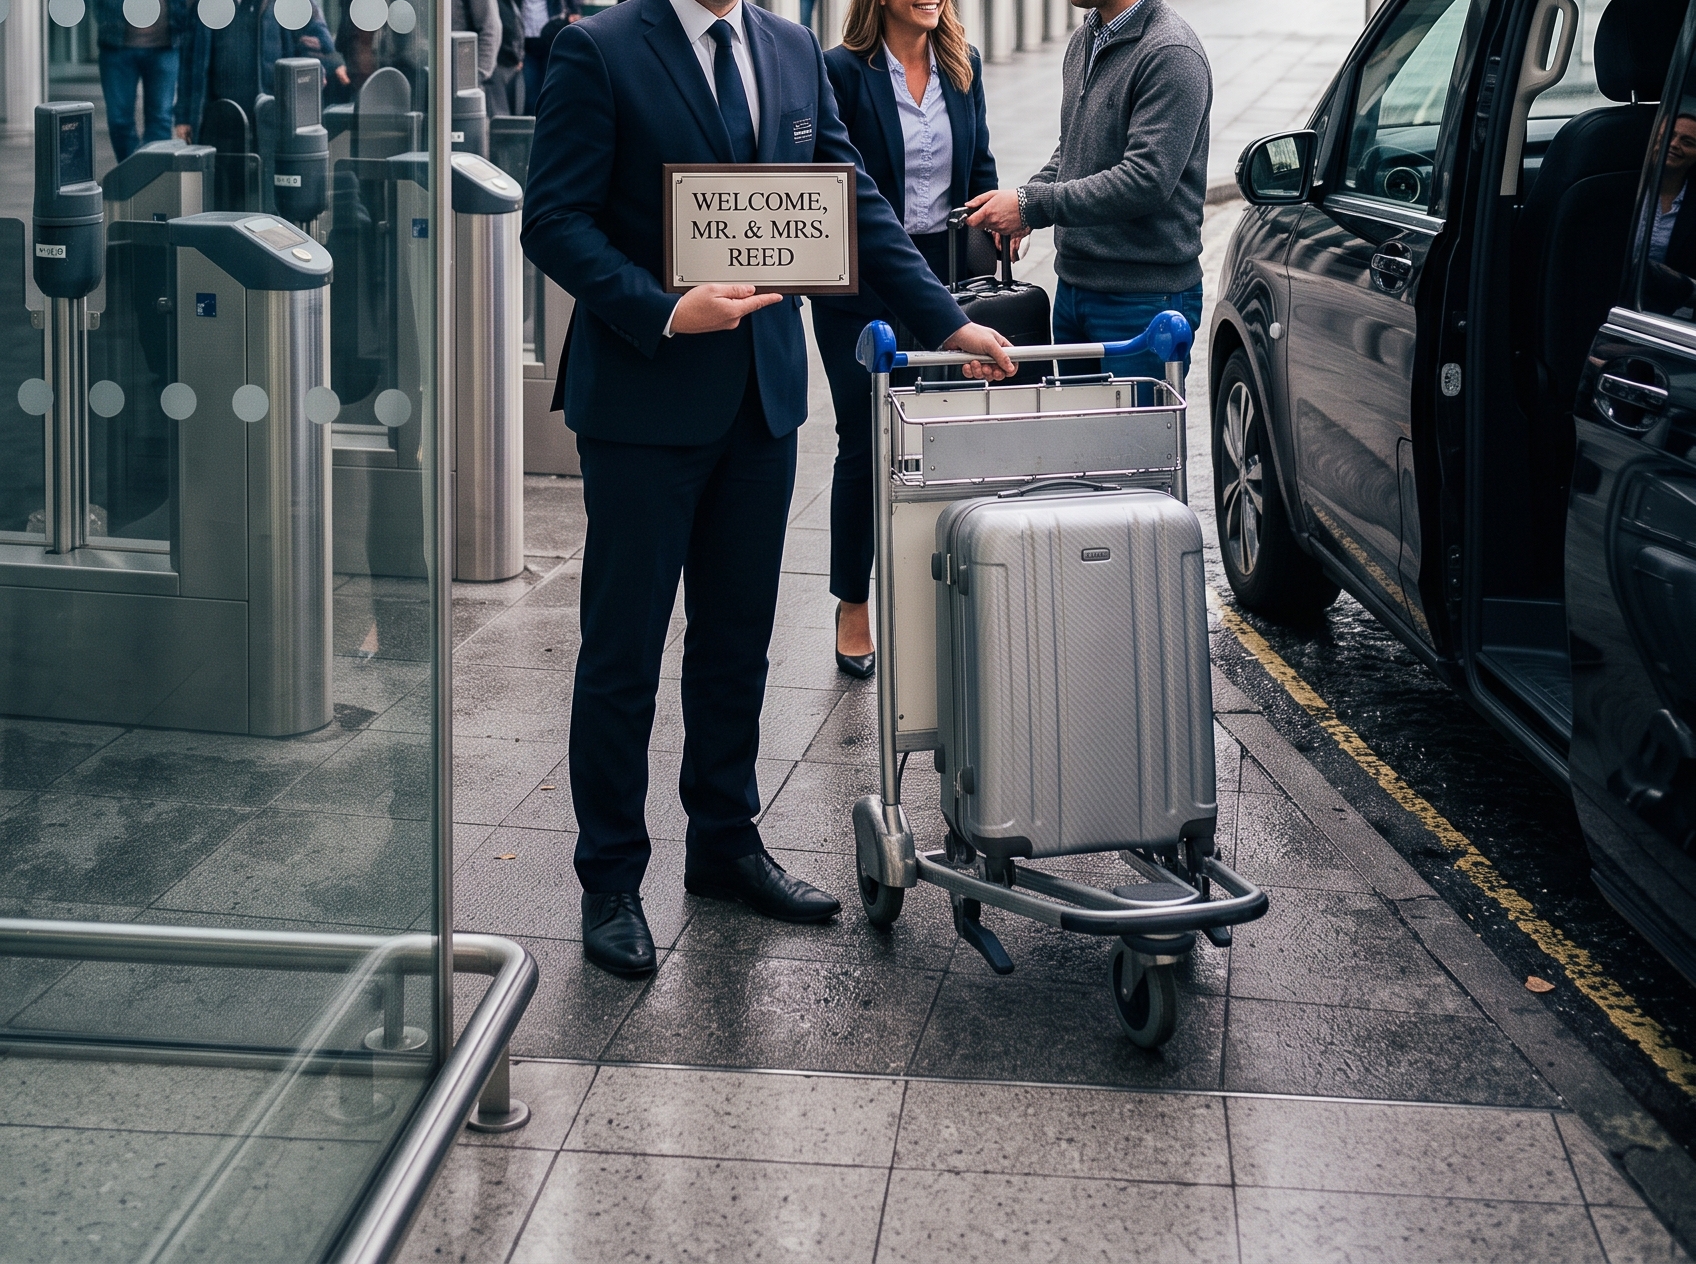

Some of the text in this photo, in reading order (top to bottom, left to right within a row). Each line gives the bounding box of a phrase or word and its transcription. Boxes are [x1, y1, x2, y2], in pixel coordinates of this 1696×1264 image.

[692, 192, 827, 214] WELCOME,
[691, 220, 829, 239] MR. & MRS.
[728, 248, 794, 266] REED
